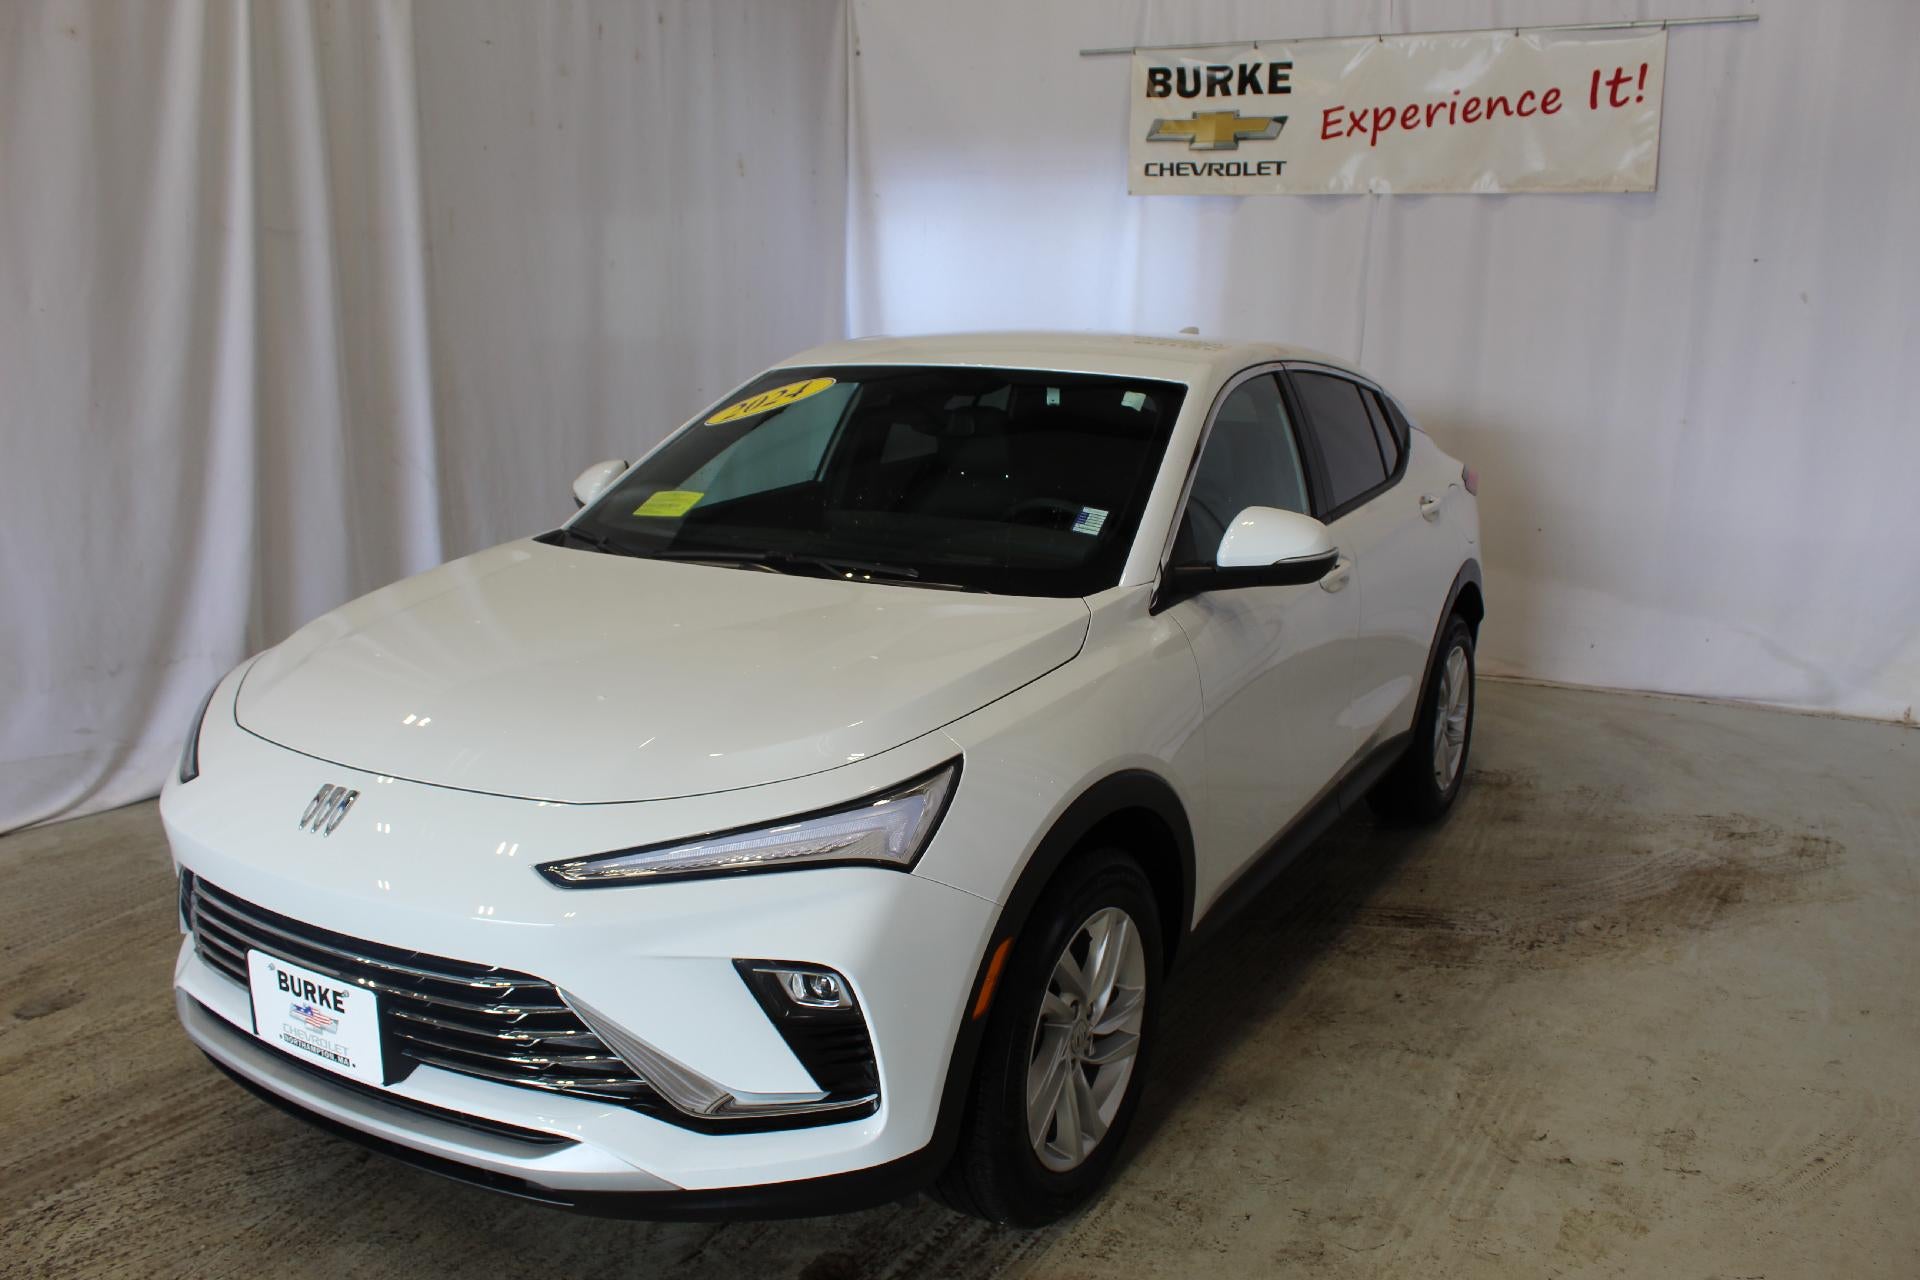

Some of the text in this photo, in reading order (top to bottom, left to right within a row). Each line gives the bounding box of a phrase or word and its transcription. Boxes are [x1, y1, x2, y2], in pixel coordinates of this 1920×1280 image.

[1146, 61, 1293, 98] BURKE
[1321, 63, 1648, 147] Experience It!
[1144, 160, 1287, 177] CHEVROLET
[722, 380, 813, 420] 2024
[277, 969, 345, 1014] BURKE
[282, 1023, 350, 1056] CHEVROLET
